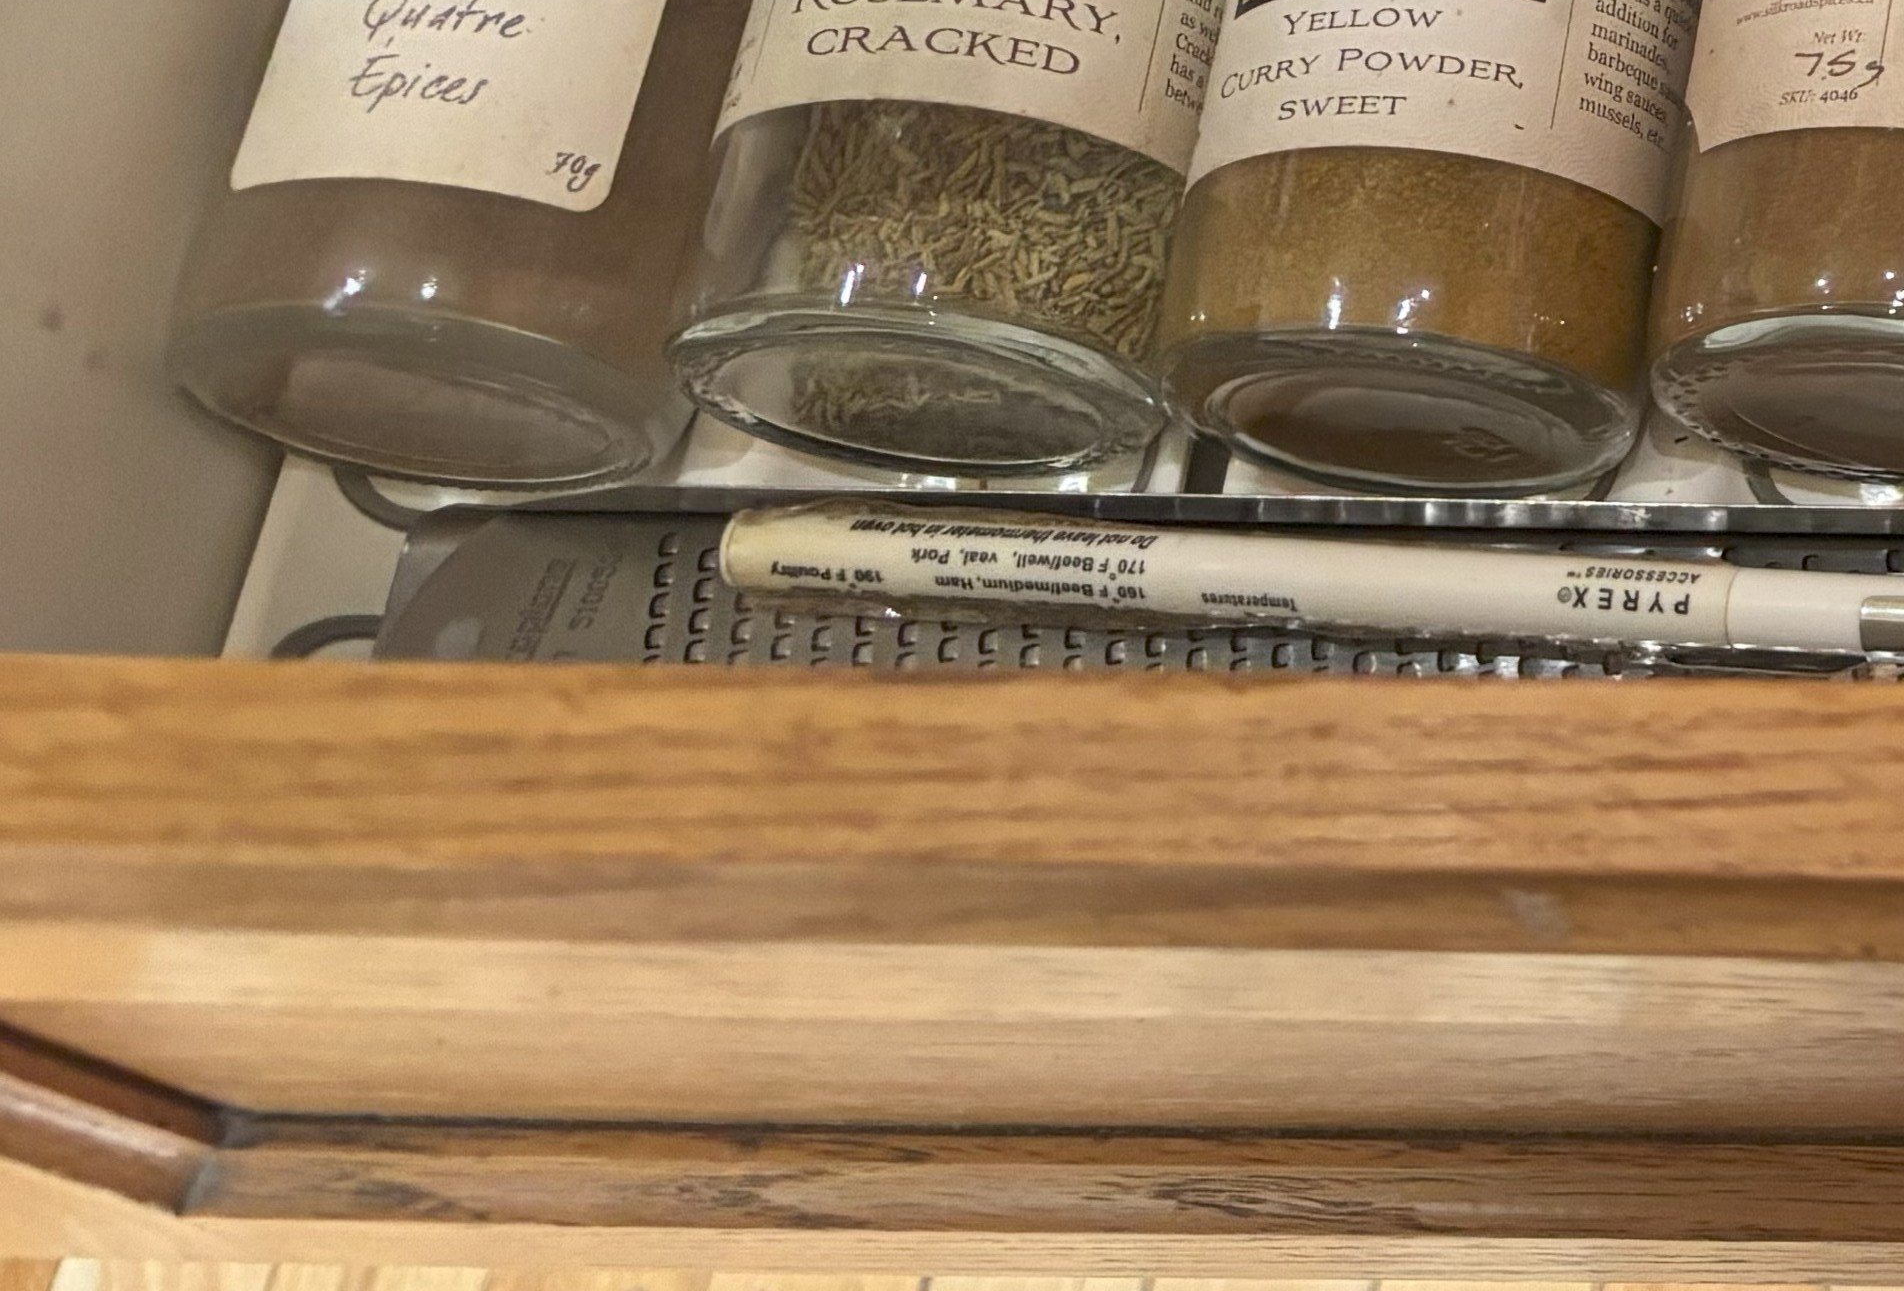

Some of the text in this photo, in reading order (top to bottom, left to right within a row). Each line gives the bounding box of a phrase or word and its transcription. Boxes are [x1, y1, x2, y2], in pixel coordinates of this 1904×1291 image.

[1282, 7, 1443, 36] YELLOW
[806, 26, 1081, 76] CRACKED
[1220, 48, 1525, 100] CURRY POWDER,
[1277, 95, 1407, 122] SWEET
